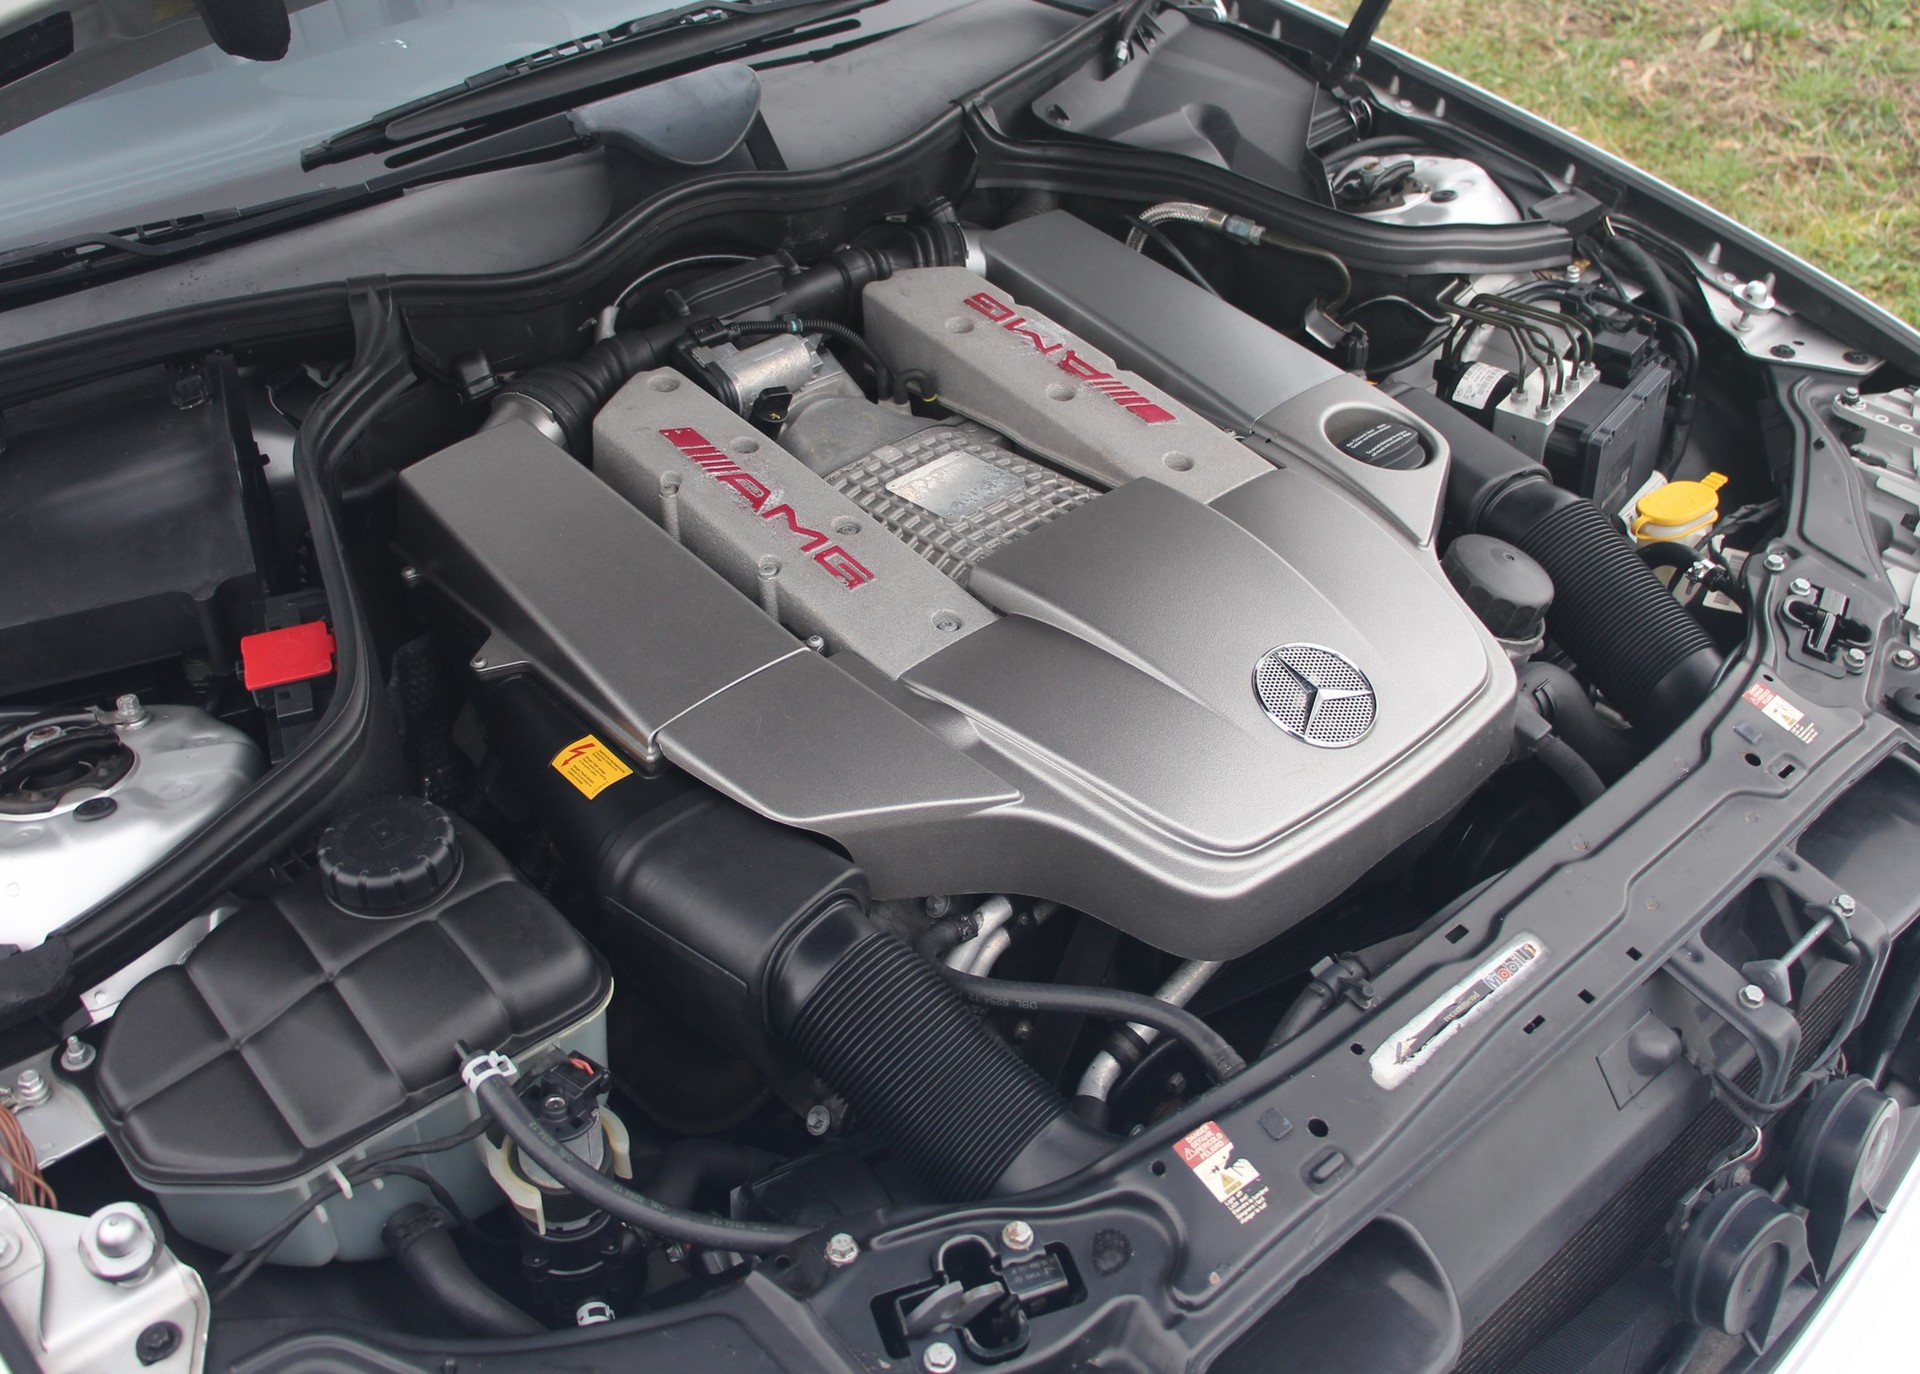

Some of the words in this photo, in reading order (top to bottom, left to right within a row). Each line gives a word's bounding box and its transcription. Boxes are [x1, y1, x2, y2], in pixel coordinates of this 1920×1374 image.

[963, 291, 1115, 381] AMG
[714, 472, 876, 591] AMG
[1443, 991, 1480, 1022] recommend
[1484, 949, 1528, 991] Mobil
